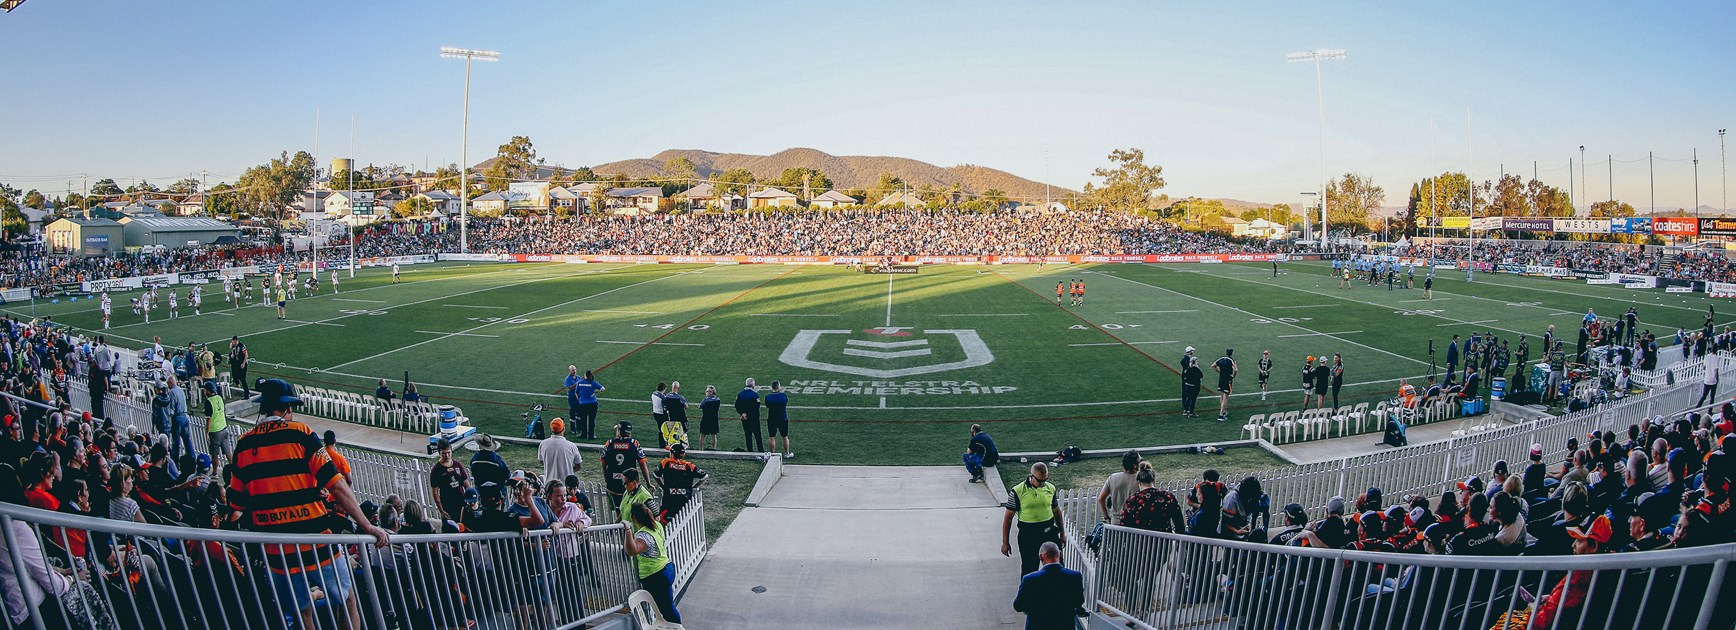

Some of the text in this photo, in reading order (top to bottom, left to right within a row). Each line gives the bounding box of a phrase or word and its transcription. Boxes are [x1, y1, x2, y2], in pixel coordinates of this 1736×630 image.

[1505, 221, 1531, 229] Mercure
[1564, 220, 1599, 229] WESTS
[525, 254, 551, 262] Ladbrokes
[830, 256, 860, 264] Ladbrokes
[916, 256, 946, 264] Ladbrokes
[1000, 255, 1030, 264] Ladbrokes
[1081, 255, 1110, 263] Ladbrokes
[789, 379, 981, 388] NRL TELSTRA
[753, 384, 1018, 396] PREMIERSHIP
[615, 453, 625, 466] 9
[270, 510, 288, 523] BUY
[289, 509, 297, 520] A
[296, 507, 311, 518] UD
